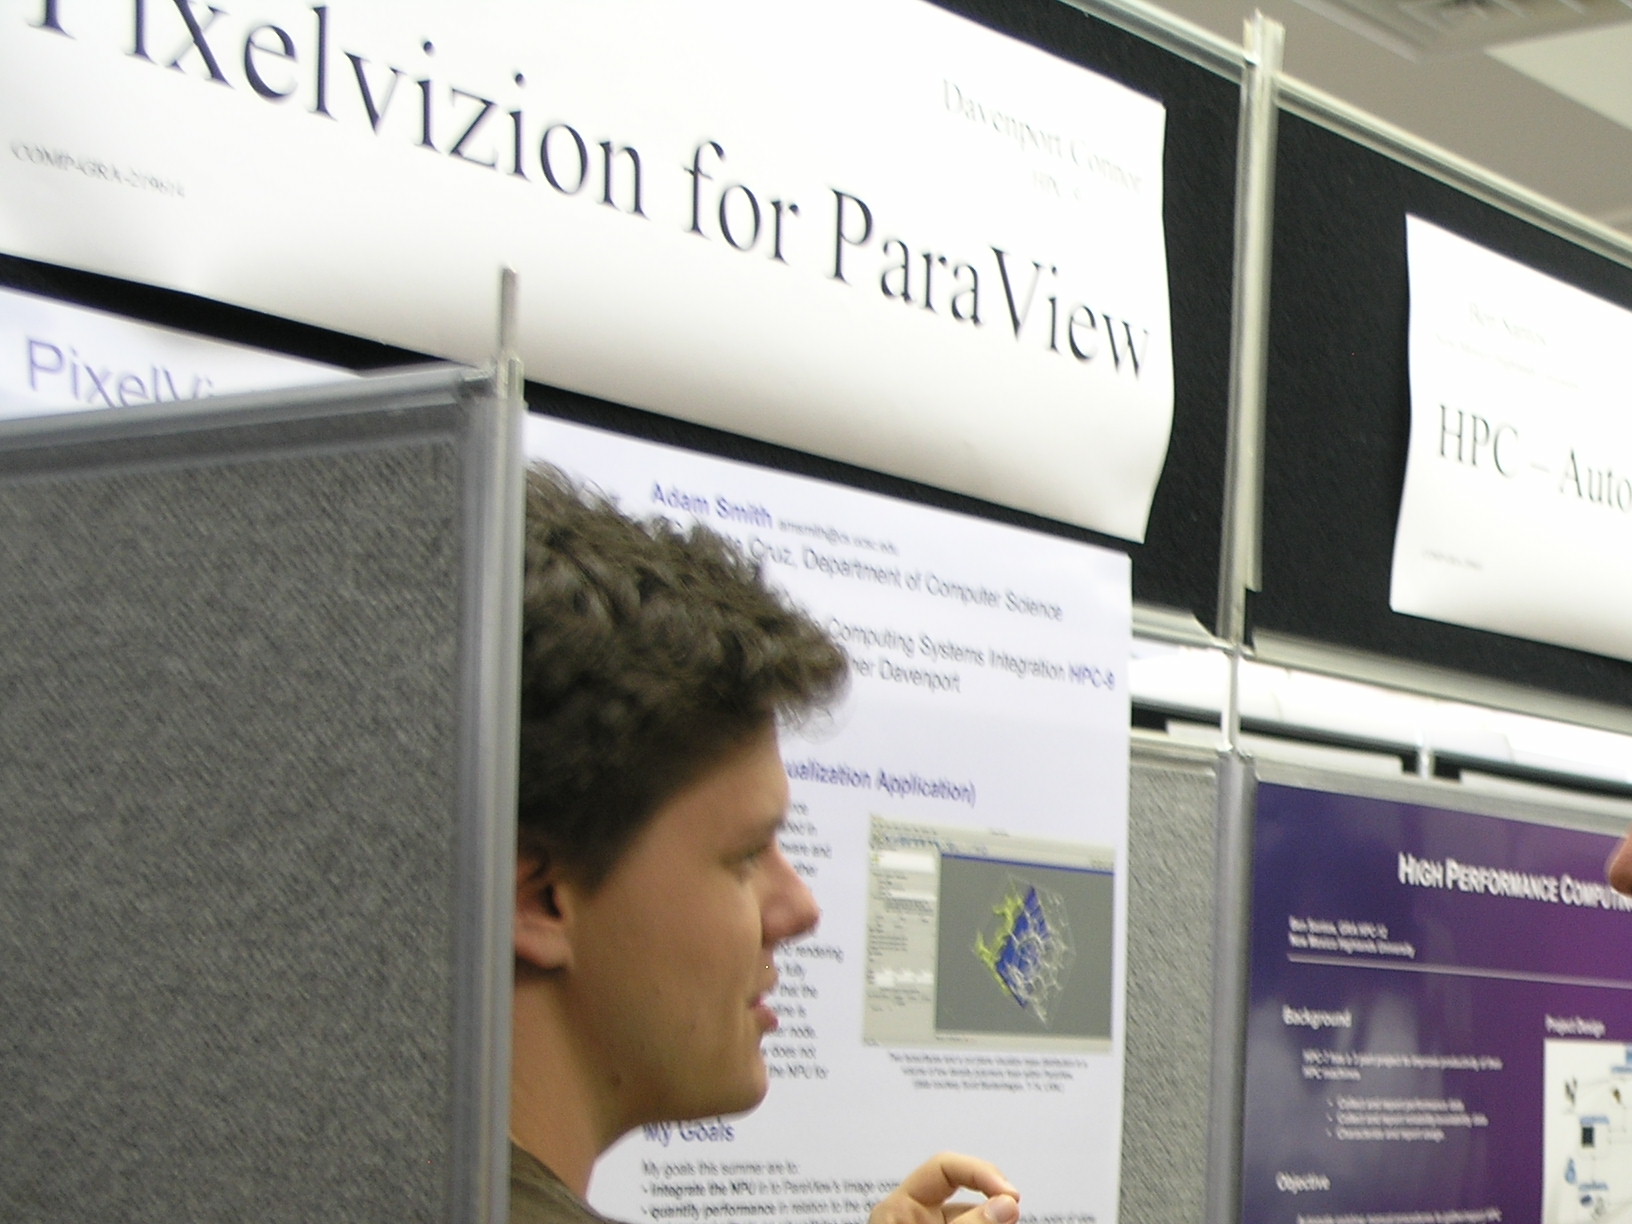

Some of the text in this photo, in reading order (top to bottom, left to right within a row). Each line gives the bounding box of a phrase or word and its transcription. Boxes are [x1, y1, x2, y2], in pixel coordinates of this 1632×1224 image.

[683, 140, 801, 265] for
[828, 186, 1150, 379] ParaView
[1436, 403, 1520, 478] HPC
[652, 480, 711, 517] Adam
[715, 495, 774, 530] Smith
[802, 547, 902, 590] Department
[906, 564, 922, 593] of
[925, 569, 1001, 609] Computer
[1003, 589, 1064, 623] Science
[828, 615, 915, 659] Computing
[918, 631, 986, 670] Systems
[988, 646, 1067, 682] Integration
[878, 659, 962, 694] Davenport
[785, 756, 977, 809] ualization Application)
[1397, 850, 1445, 889] HIGH
[1446, 857, 1560, 905] PERFORMANCE
[1282, 1003, 1353, 1031] Background
[678, 1117, 736, 1144] Goals
